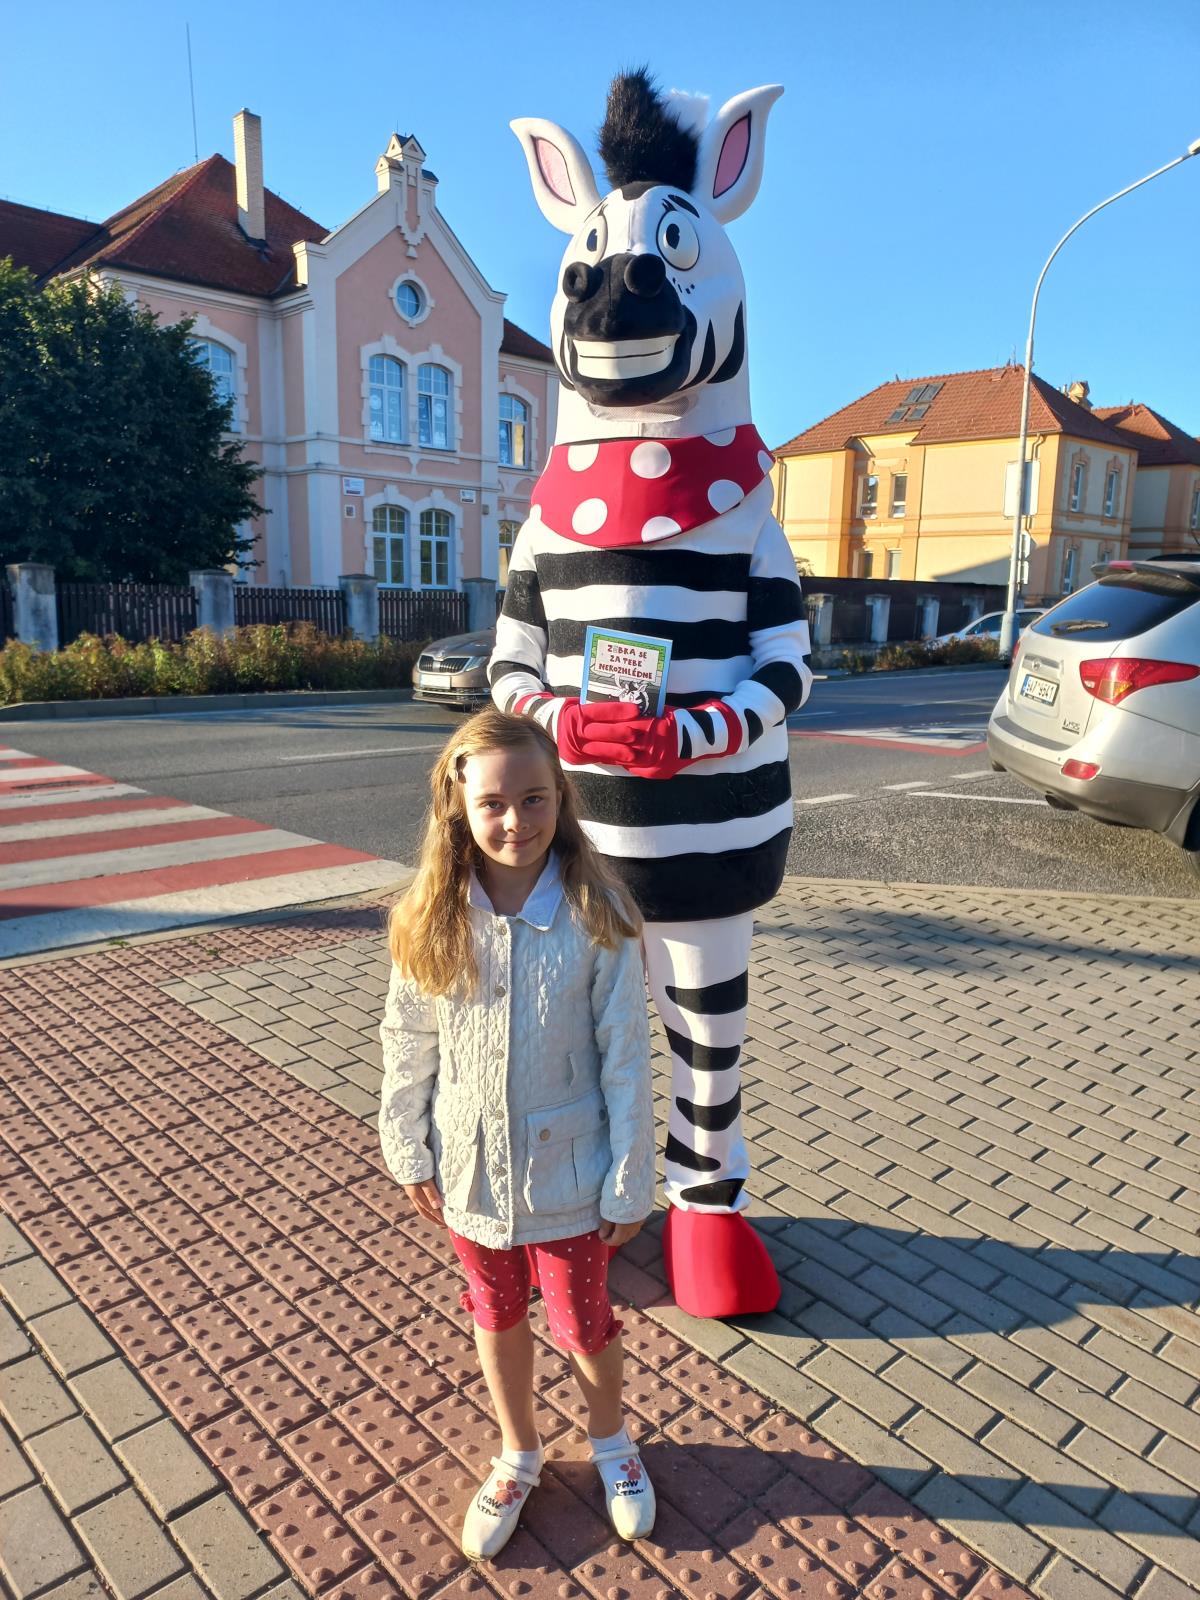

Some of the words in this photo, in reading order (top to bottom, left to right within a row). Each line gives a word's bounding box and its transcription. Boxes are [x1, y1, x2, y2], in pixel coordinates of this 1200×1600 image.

[610, 655, 620, 663] ZA
[623, 657, 642, 667] TEBE
[638, 651, 647, 659] SE
[598, 663, 652, 679] NEROZHLÉDNE
[615, 1480, 639, 1490] PAW
[482, 1495, 503, 1510] PAW
